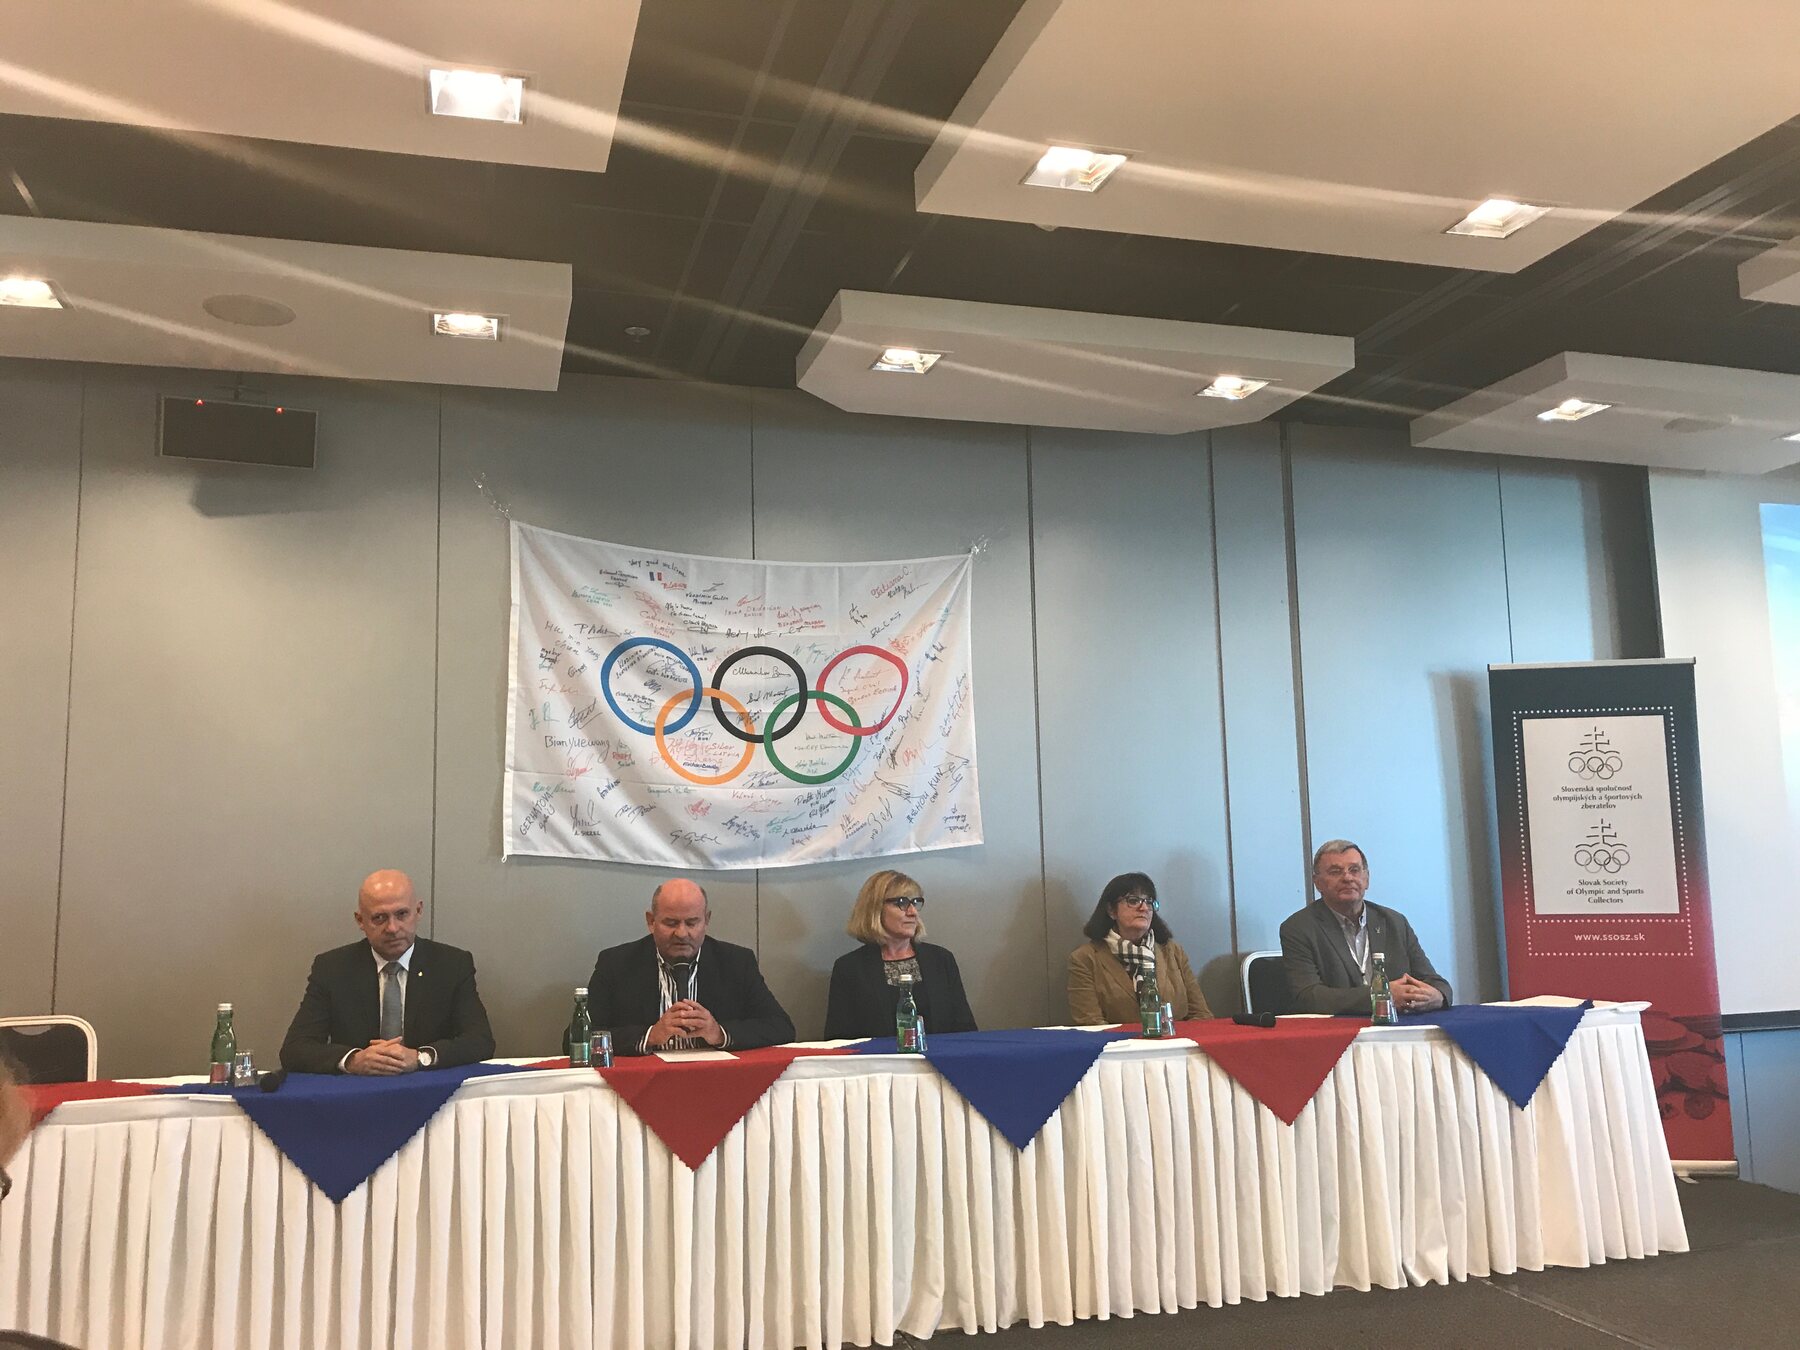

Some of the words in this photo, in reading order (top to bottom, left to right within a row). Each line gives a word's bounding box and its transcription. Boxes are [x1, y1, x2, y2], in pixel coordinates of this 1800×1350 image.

[1553, 794, 1596, 802] olympijských
[1604, 793, 1643, 802] športových
[1602, 879, 1628, 887] Society
[1575, 888, 1605, 896] Olympic
[1621, 887, 1644, 896] Sports
[1587, 896, 1624, 904] Collectors
[1574, 932, 1646, 941] www.ssosz.sk
